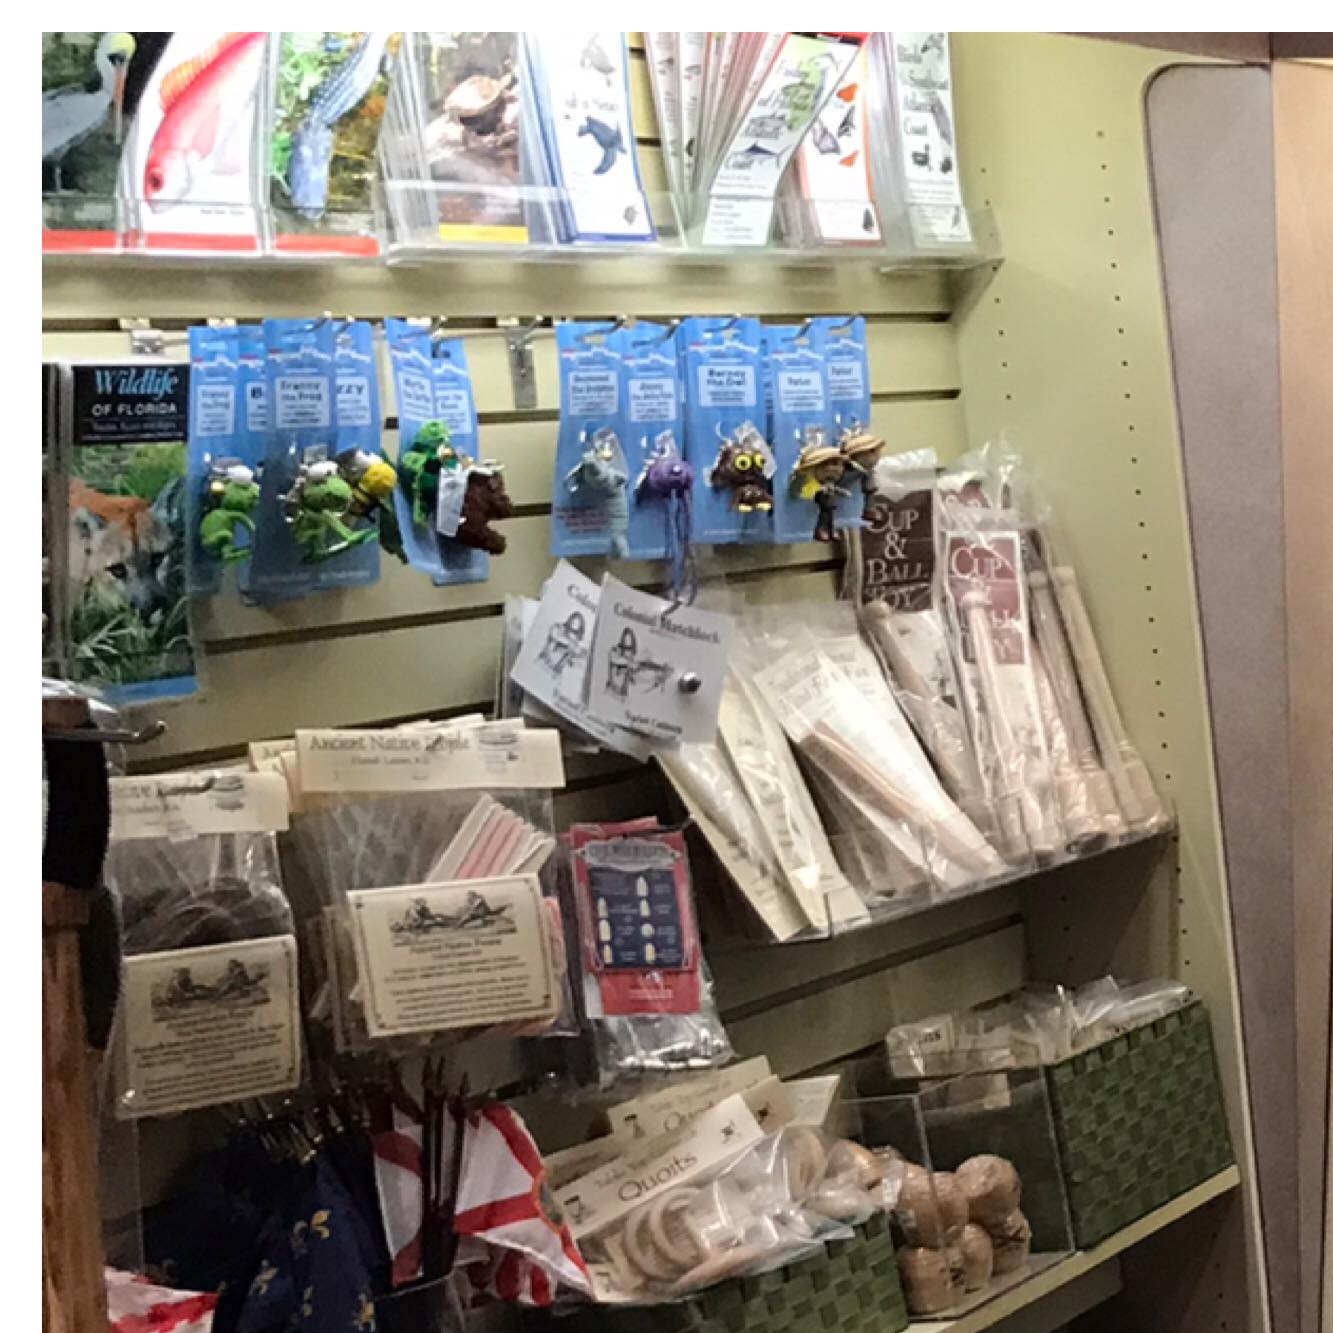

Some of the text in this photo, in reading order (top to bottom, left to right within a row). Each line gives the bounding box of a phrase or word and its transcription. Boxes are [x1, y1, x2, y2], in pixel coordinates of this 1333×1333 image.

[93, 367, 179, 397] Wildlife
[91, 402, 178, 416] OF FLORIDA
[615, 1151, 699, 1205] Quoits
